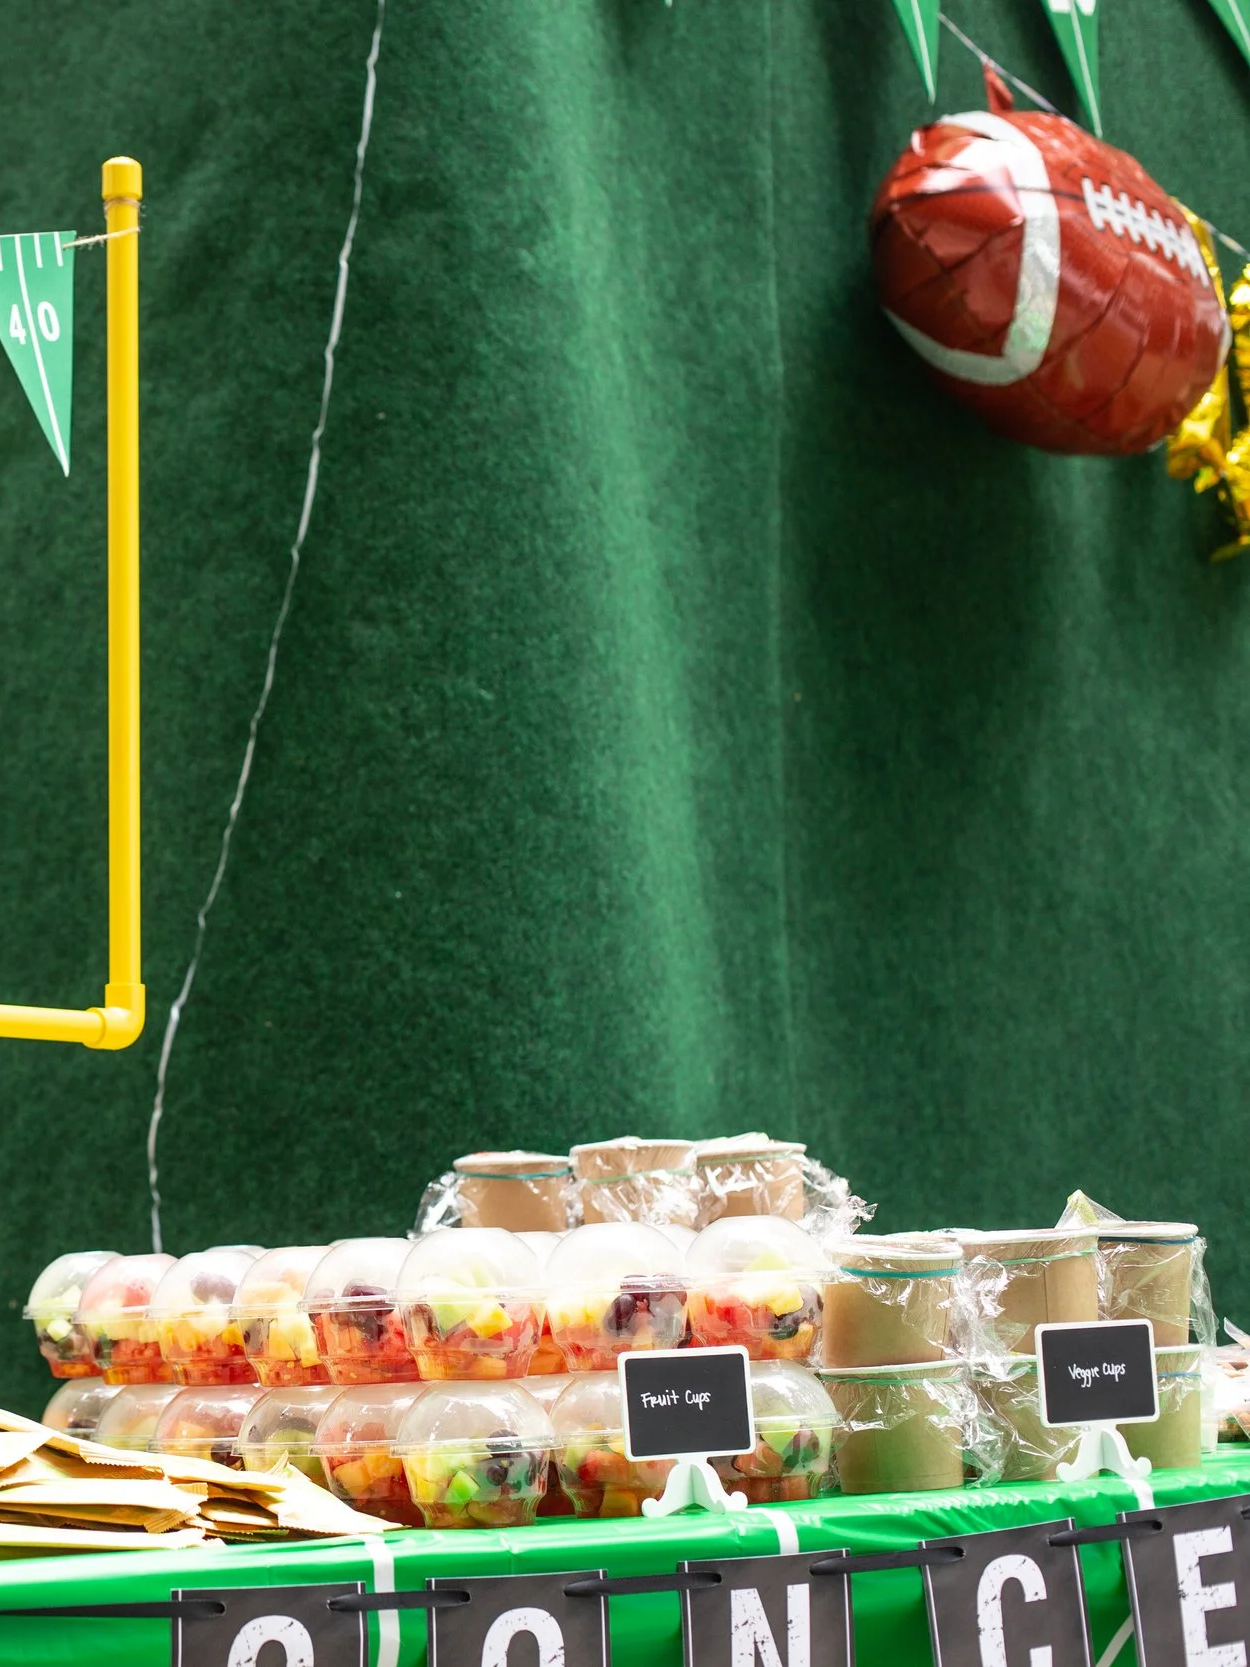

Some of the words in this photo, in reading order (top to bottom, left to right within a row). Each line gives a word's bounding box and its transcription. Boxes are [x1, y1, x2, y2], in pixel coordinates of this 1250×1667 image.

[9, 300, 61, 345] 40
[1068, 1363, 1100, 1388] Veggie
[640, 1389, 680, 1409] Fruit
[685, 1389, 712, 1411] Cups
